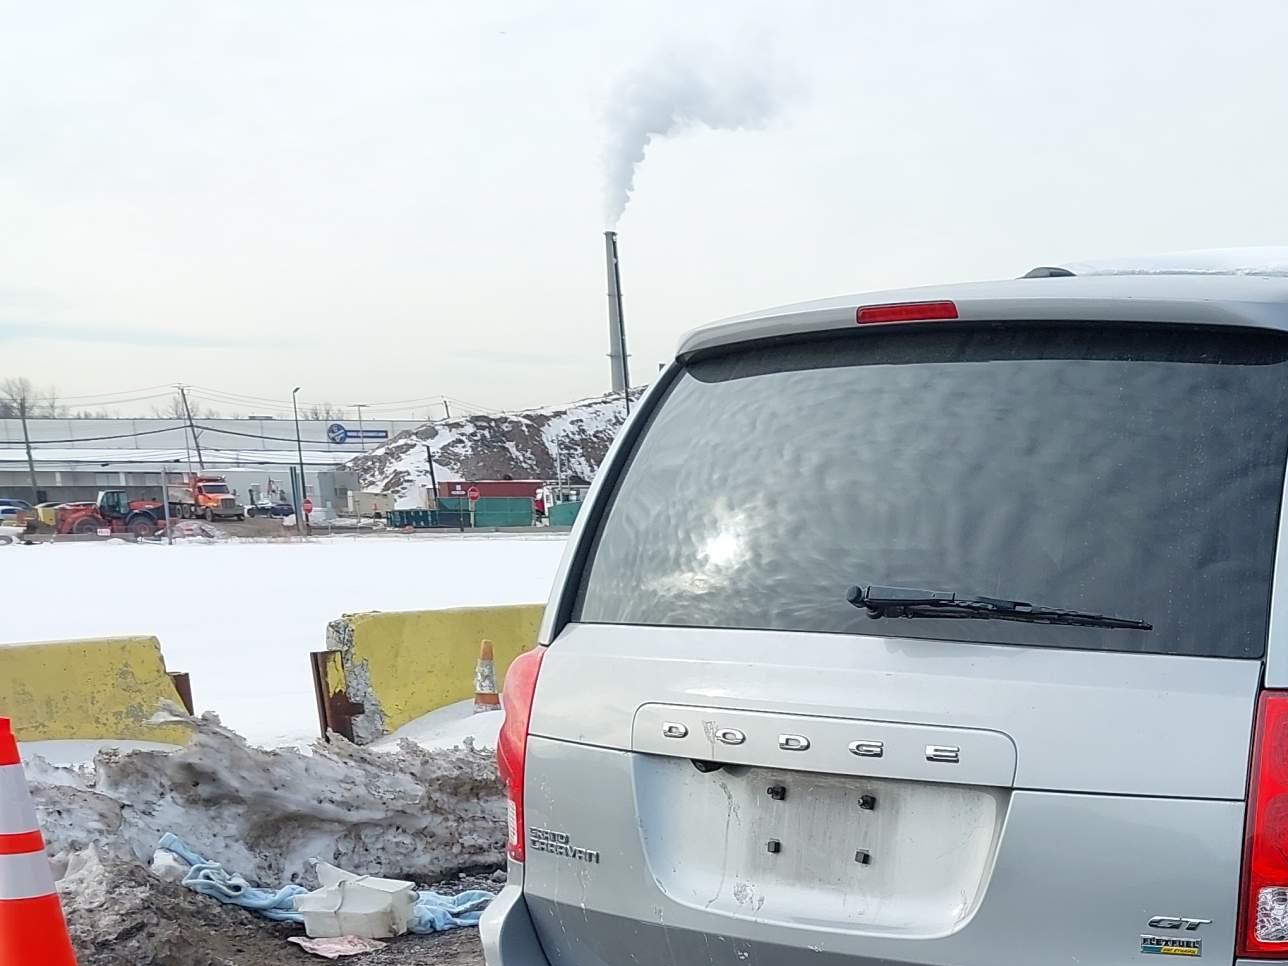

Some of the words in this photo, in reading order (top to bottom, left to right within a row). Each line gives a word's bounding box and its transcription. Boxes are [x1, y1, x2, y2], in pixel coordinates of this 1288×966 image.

[662, 721, 960, 764] DODGE
[1147, 915, 1214, 931] GT
[1141, 936, 1201, 949] FLEXFUEL
